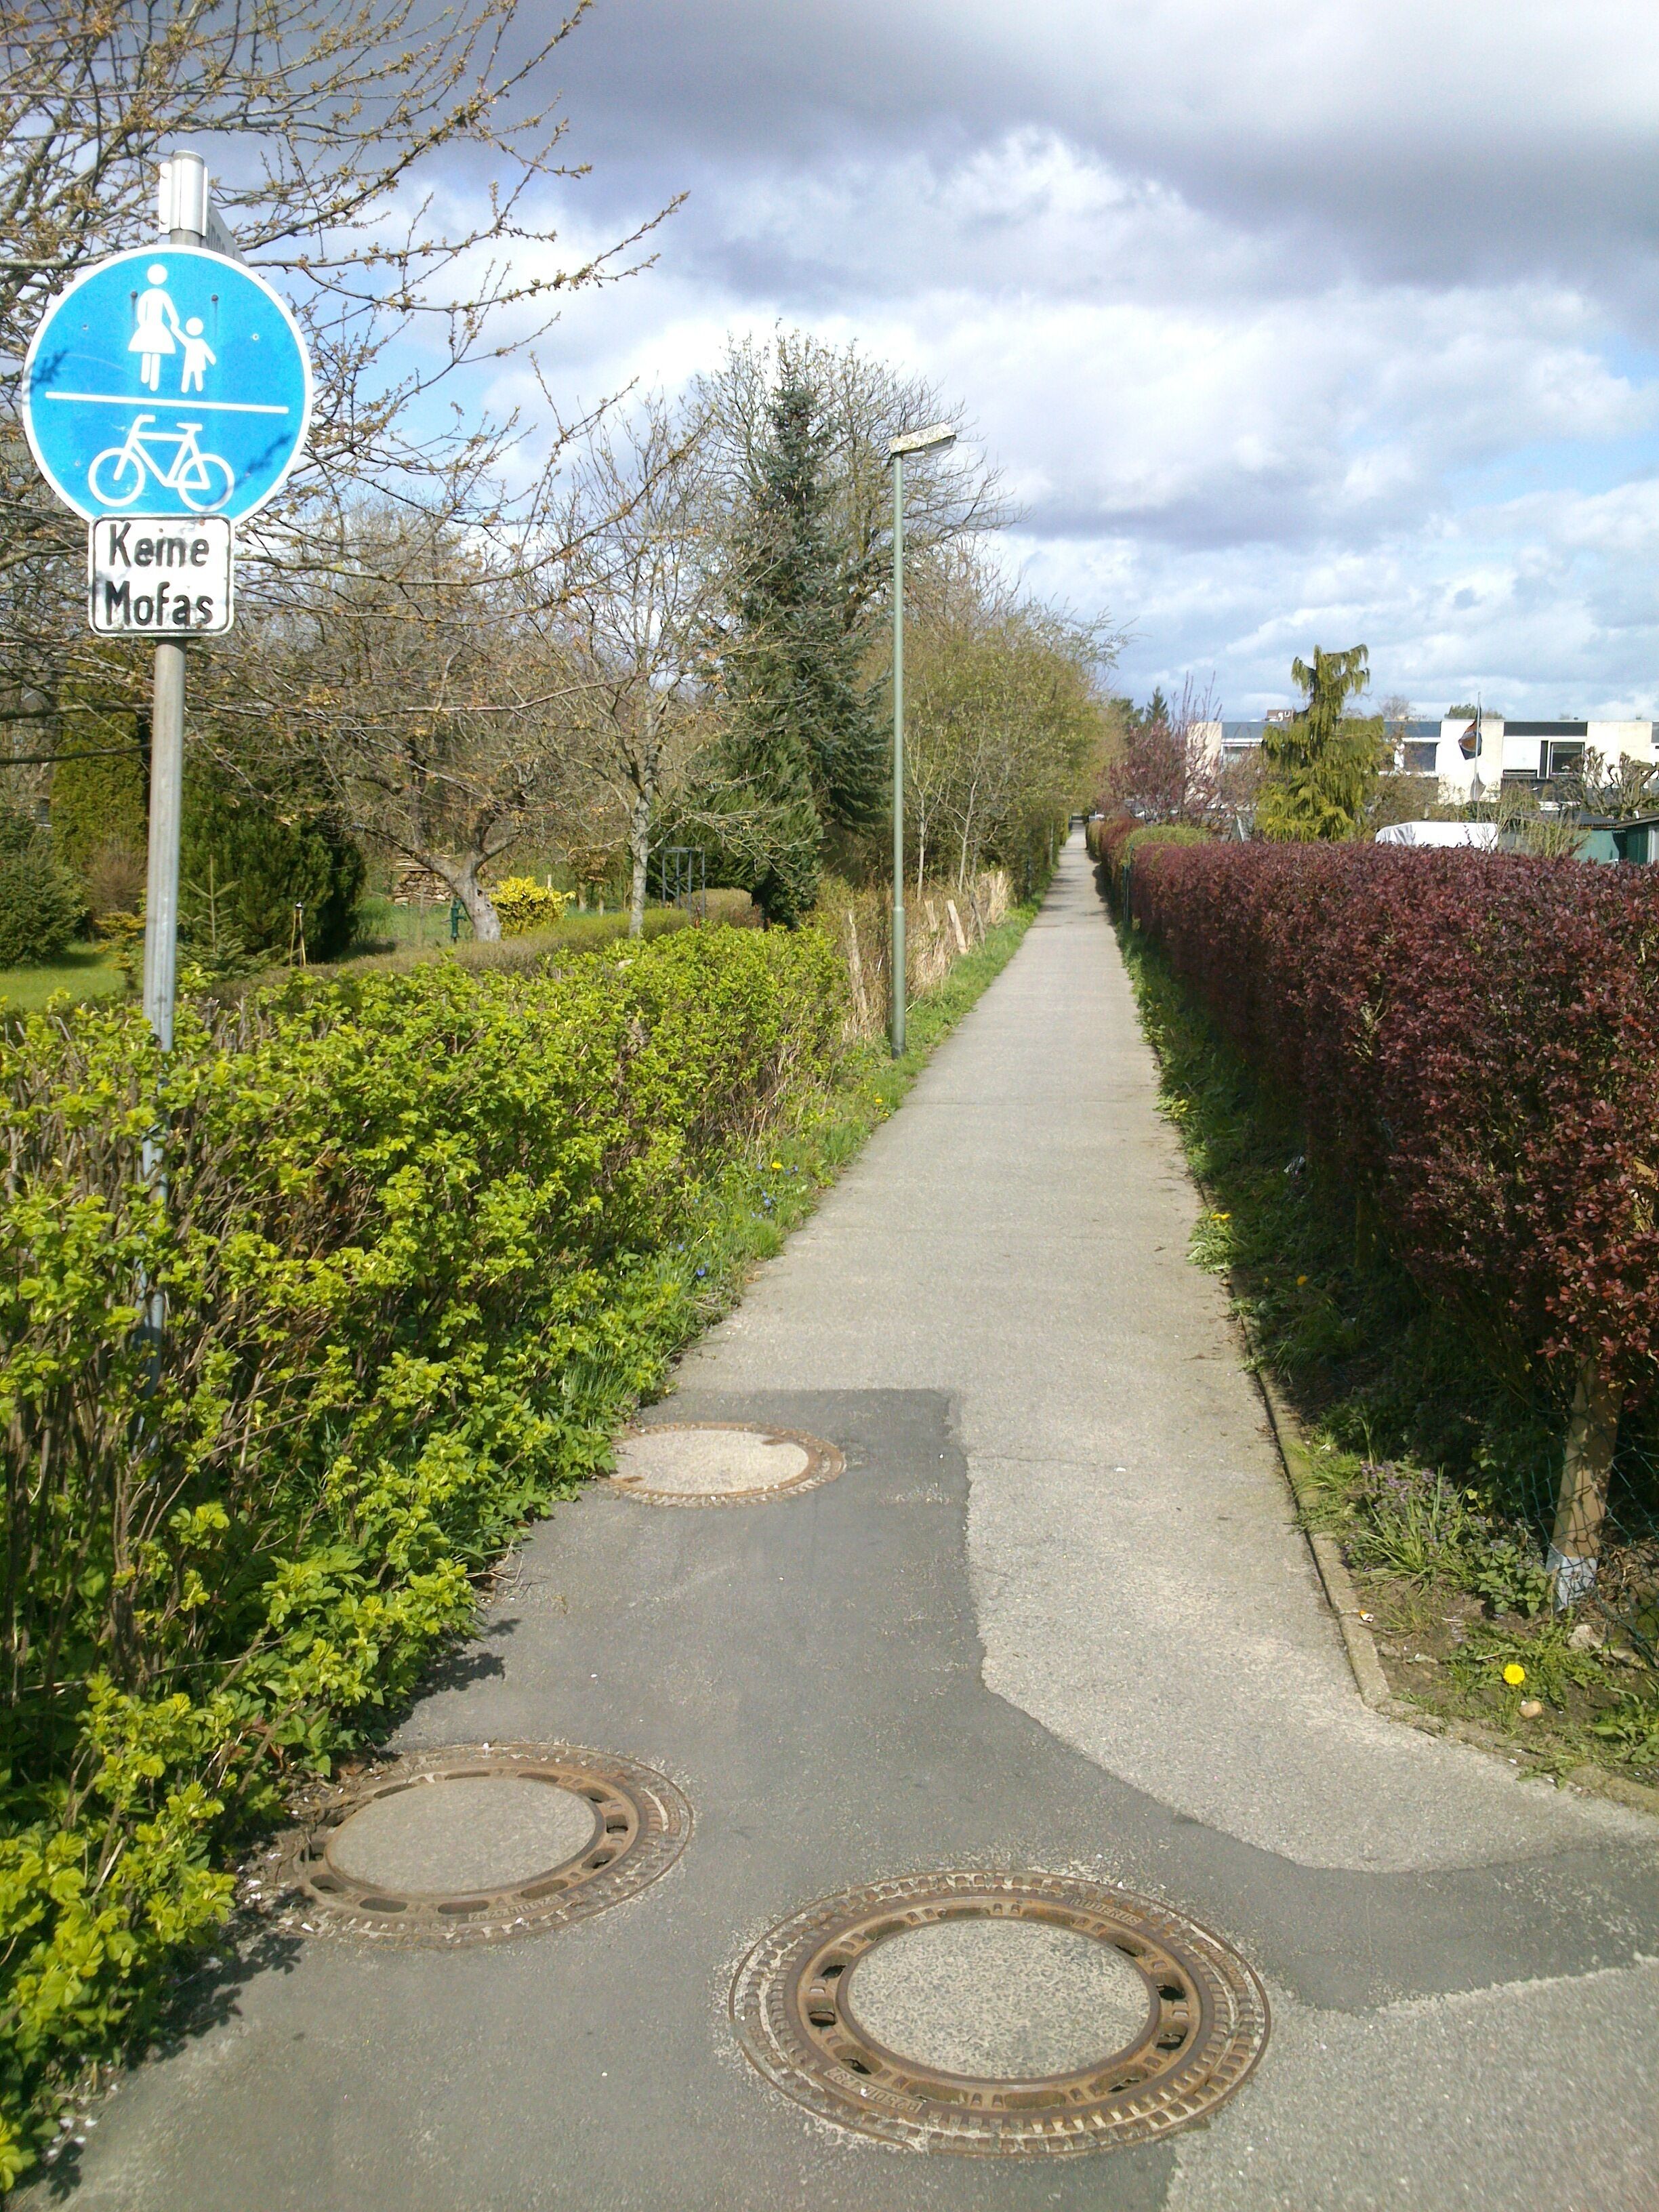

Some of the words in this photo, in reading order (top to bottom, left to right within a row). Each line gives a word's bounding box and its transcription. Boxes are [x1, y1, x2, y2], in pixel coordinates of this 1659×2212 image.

[109, 522, 209, 567] Keine
[106, 580, 213, 626] Mofas
[1073, 1896, 1140, 1926] BUDERUS
